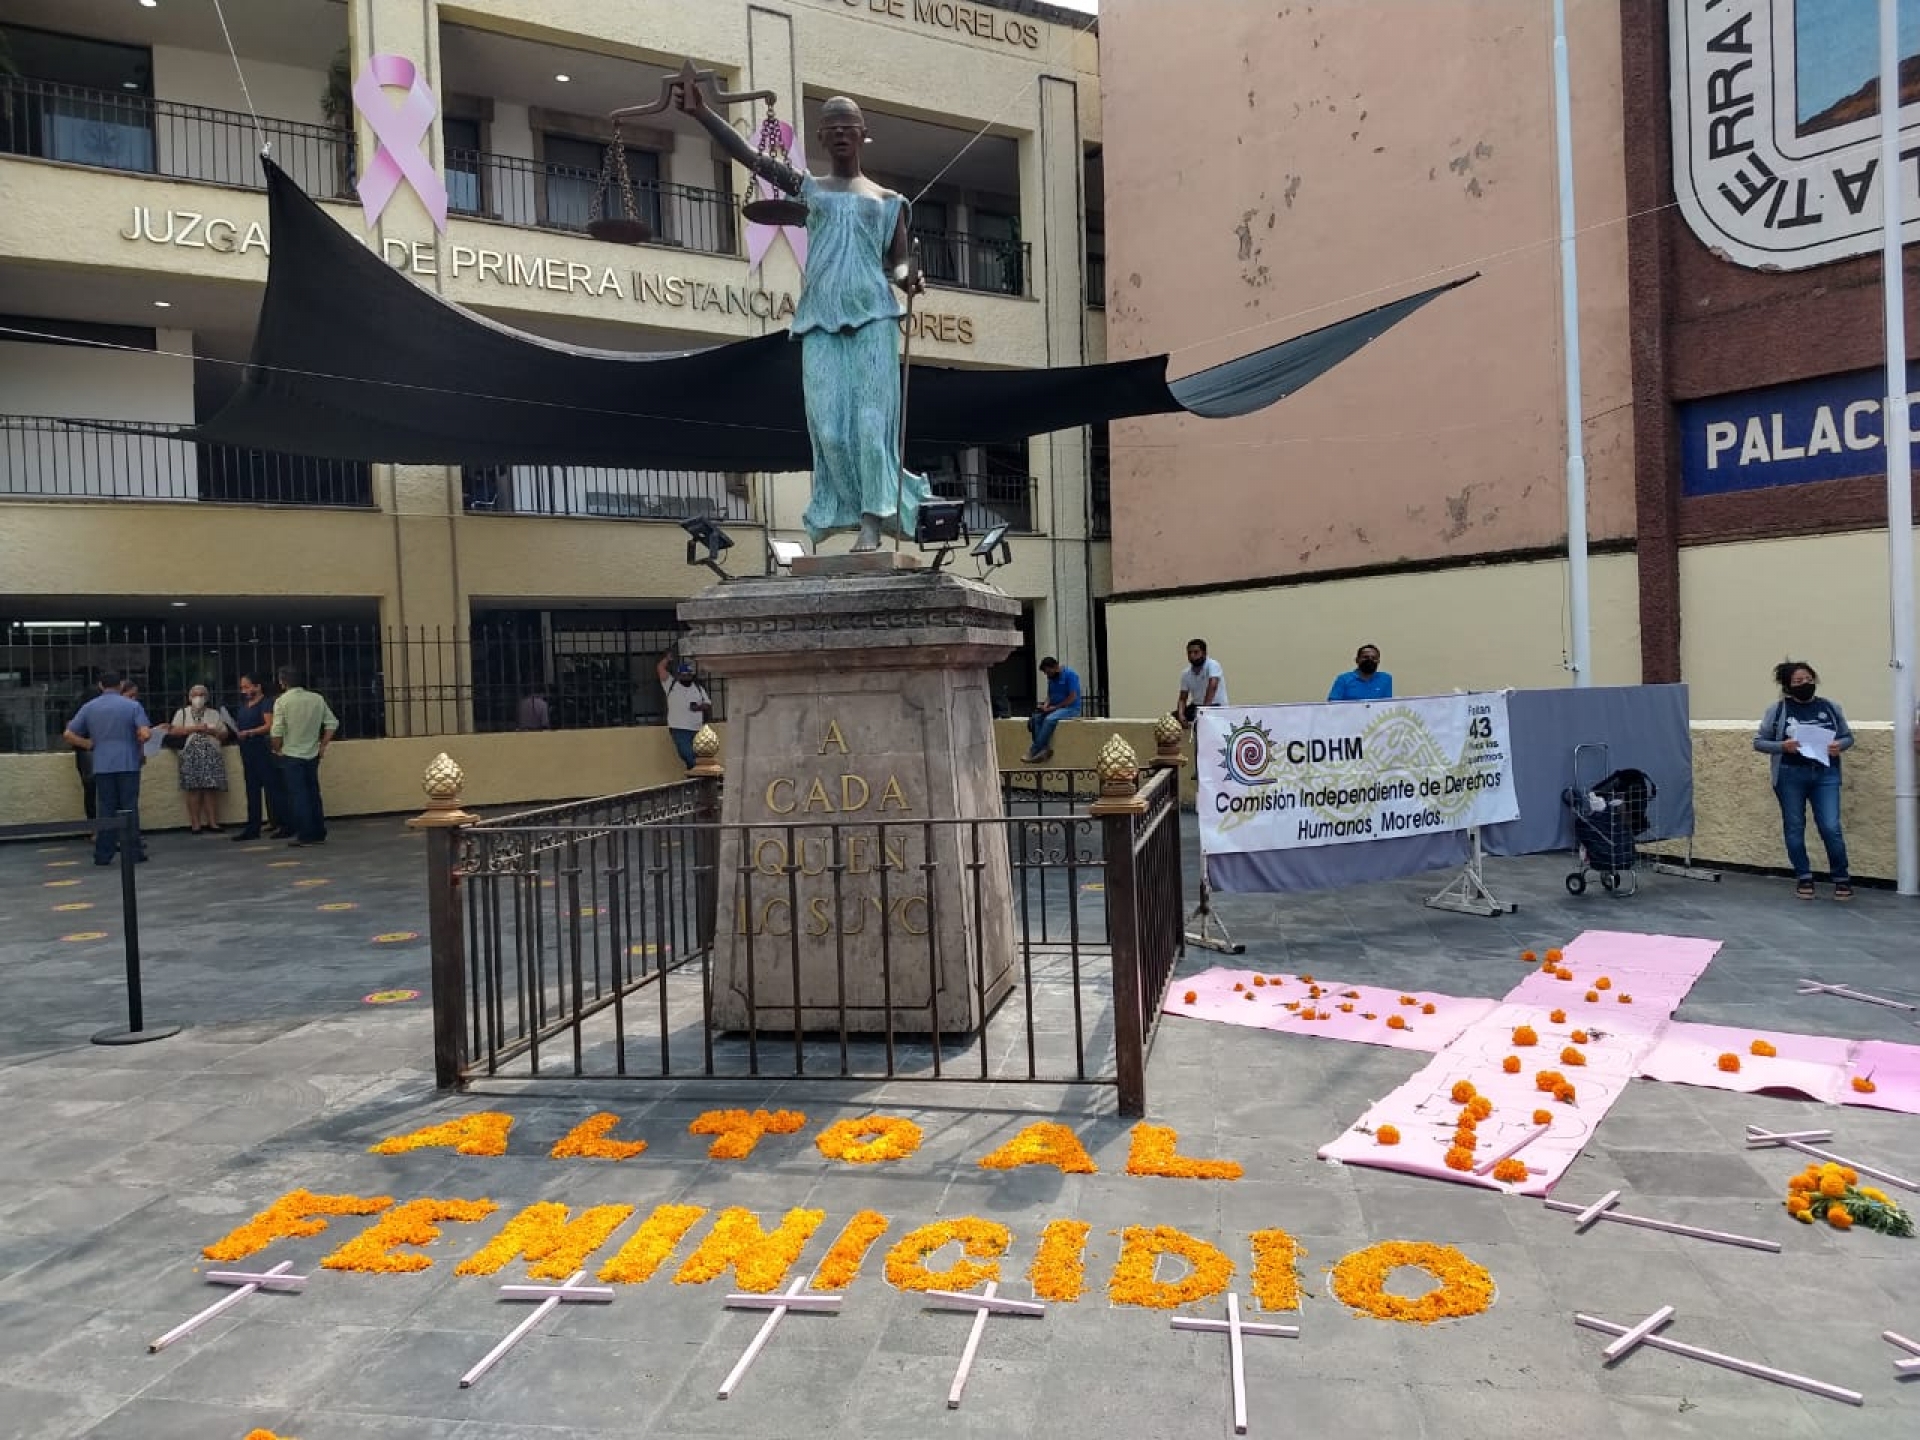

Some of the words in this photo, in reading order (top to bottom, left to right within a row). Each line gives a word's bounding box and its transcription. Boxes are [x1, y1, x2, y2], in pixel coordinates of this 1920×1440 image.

[914, 0, 1039, 48] MORELOS
[1705, 12, 1822, 229] TIERRA
[120, 205, 270, 256] JUZGA
[383, 237, 437, 276] DE
[452, 246, 624, 299] PRIMERA
[632, 271, 796, 320] INSTANCIA
[900, 312, 974, 344] ORES
[1706, 390, 1920, 470] PALAC
[818, 719, 850, 754] A
[1469, 716, 1492, 739] 43
[1286, 737, 1363, 764] CIDHM
[766, 774, 912, 814] CADA
[1216, 786, 1296, 814] Comisión
[1300, 779, 1414, 810] Independiente
[1419, 777, 1441, 797] de
[1445, 770, 1502, 795] Derechos
[1297, 817, 1372, 841] Humanos
[754, 836, 907, 877] QUEN
[369, 1109, 923, 1164] ALTO
[978, 1120, 1244, 1181] AL
[202, 1187, 1498, 1324] FEMINICIDIO
